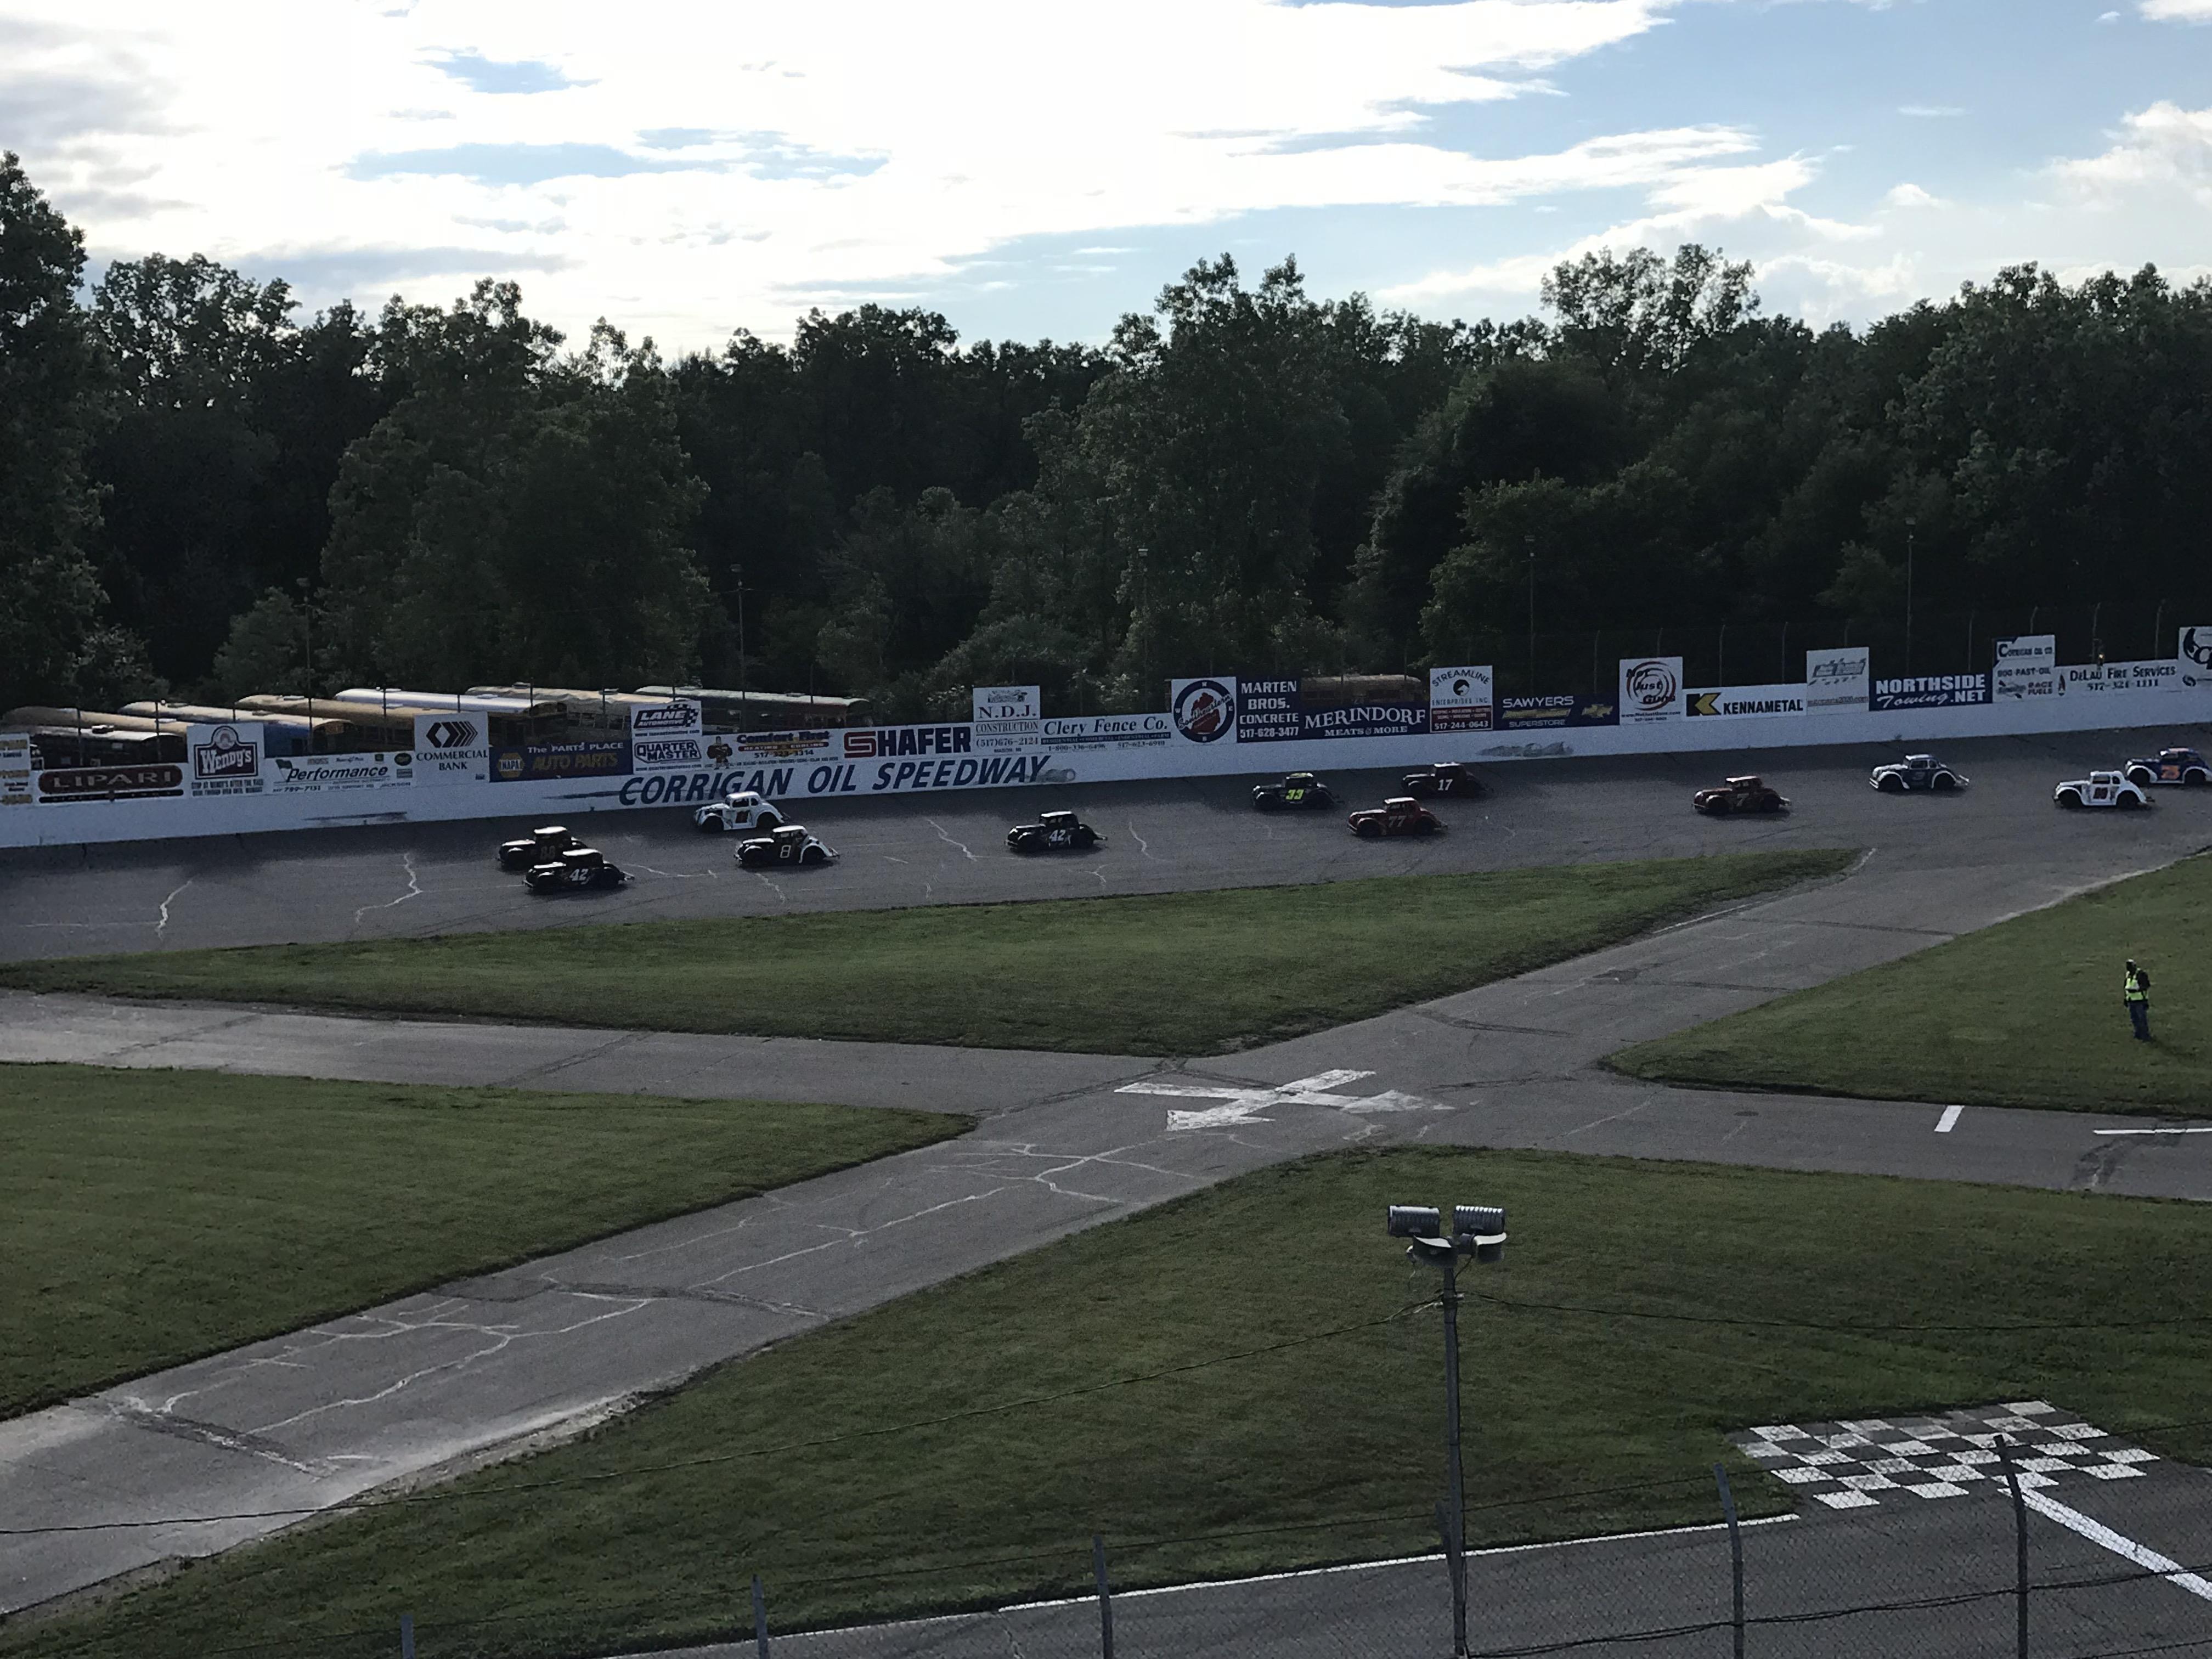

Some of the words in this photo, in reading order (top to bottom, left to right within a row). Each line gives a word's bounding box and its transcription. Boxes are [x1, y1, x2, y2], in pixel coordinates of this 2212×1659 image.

[1432, 669, 1490, 687] STREAMLINE
[1241, 681, 1297, 693] MARTEN
[1876, 674, 1985, 695] NORTHSIDE
[1248, 698, 1290, 709] BROS.
[1503, 696, 1574, 708] SAWYERS
[1877, 693, 1949, 708] Towing
[978, 704, 1036, 719] N.D.J.
[1724, 699, 1803, 715] KENNAMETAL
[640, 710, 686, 720] LANE
[1240, 713, 1299, 724] CONCRETE
[1304, 707, 1426, 730] MERINDORF
[976, 721, 1039, 733] CONSTRUCTION
[1044, 721, 1087, 736] Clery
[1094, 718, 1137, 733] Fence
[1144, 716, 1167, 730] Co.
[1509, 719, 1566, 727] SUPERSTORE
[1324, 729, 1364, 737] MEATS
[1374, 726, 1408, 734] MORE
[551, 744, 585, 752] PARTS
[844, 726, 971, 758] SHAFER
[416, 749, 488, 761] COMMERCIAL
[636, 742, 695, 757] QUARTER
[647, 750, 697, 761] MASTER
[439, 761, 468, 771] BANK
[501, 759, 521, 771] NAPA
[533, 755, 571, 770] AUTO
[574, 753, 618, 768] PARTS
[54, 771, 171, 788] LIPARI
[286, 766, 389, 782] Performance
[619, 768, 793, 806] CORRIGAN
[808, 764, 857, 793] OIL
[872, 755, 1051, 791] SPEEDWAY
[1438, 779, 1453, 791] 17
[1285, 789, 1305, 800] 33
[1388, 816, 1407, 828] 77
[1049, 830, 1066, 842] 42
[780, 845, 791, 858] 8
[569, 869, 589, 882] 42
